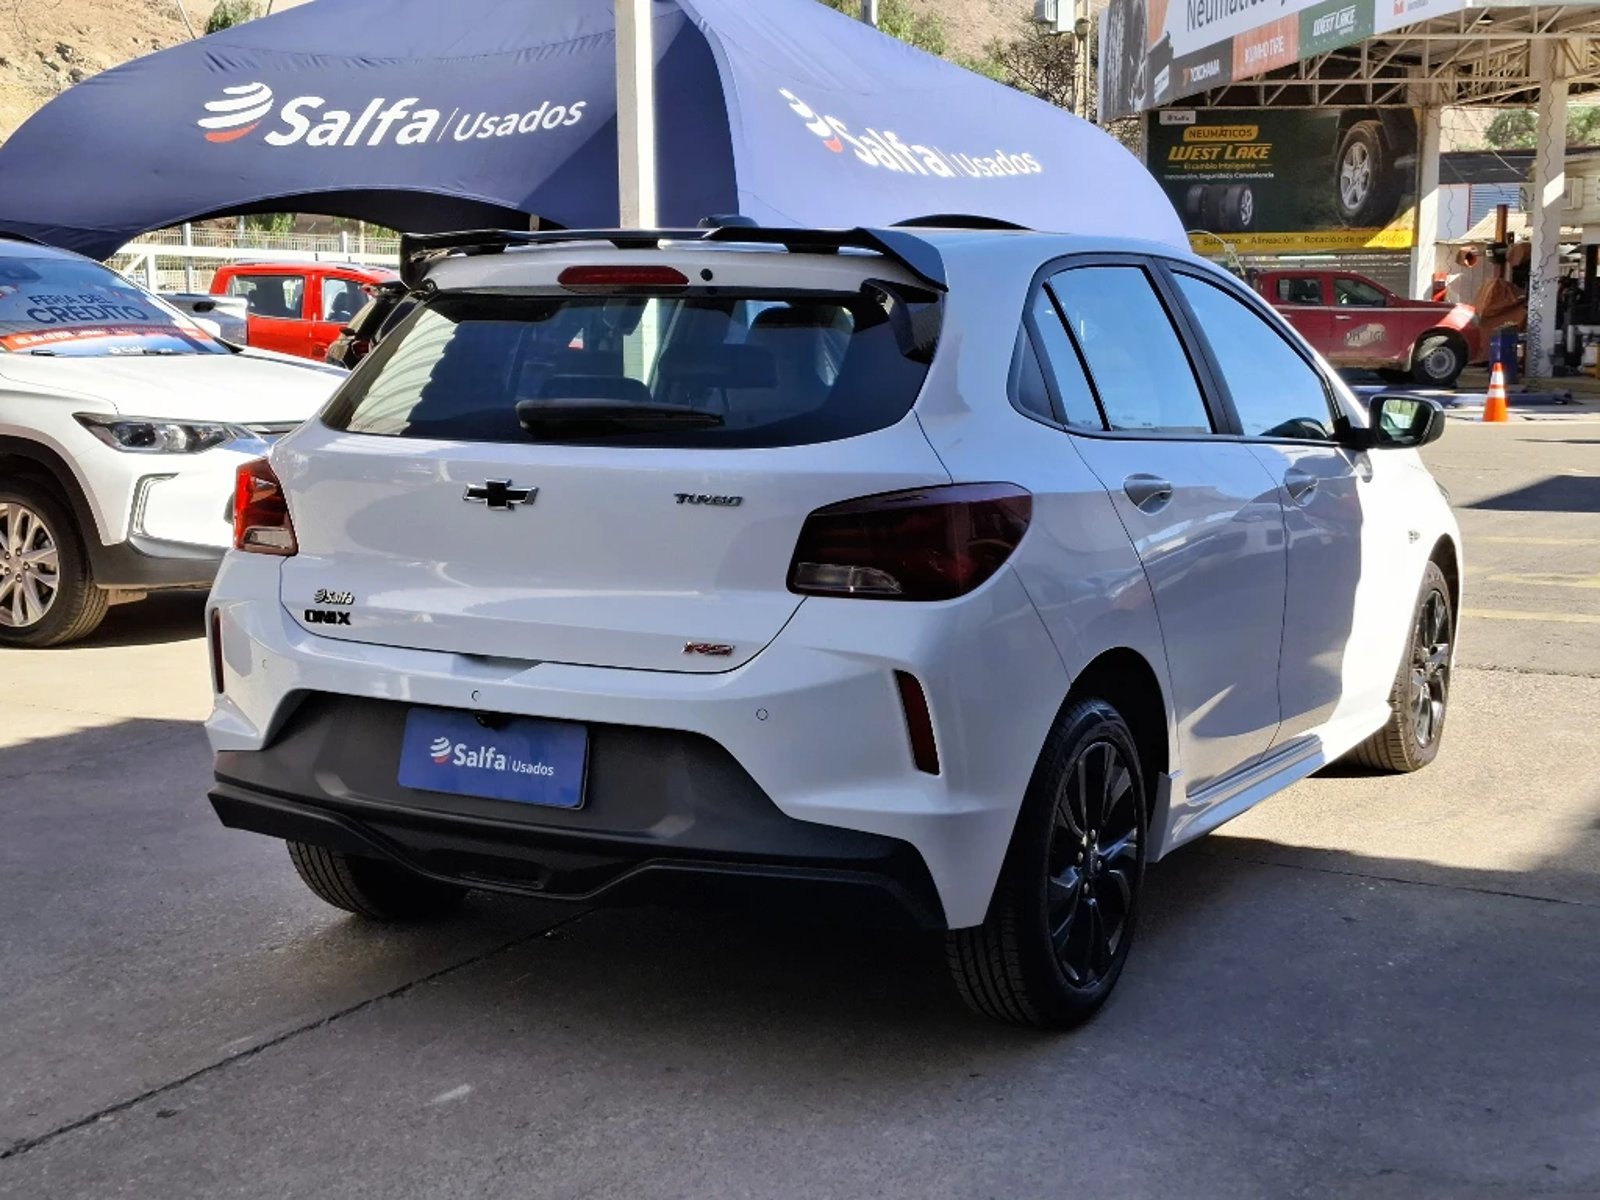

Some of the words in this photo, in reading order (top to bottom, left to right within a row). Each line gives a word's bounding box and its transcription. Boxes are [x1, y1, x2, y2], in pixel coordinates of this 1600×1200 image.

[264, 96, 441, 147] Salfa
[453, 100, 587, 143] Usados
[824, 114, 956, 178] Salfa
[952, 149, 1044, 178] Usados
[27, 293, 76, 306] FERIA
[304, 609, 351, 626] ONIX
[452, 743, 507, 771] Salfa
[511, 759, 555, 776] Usados
